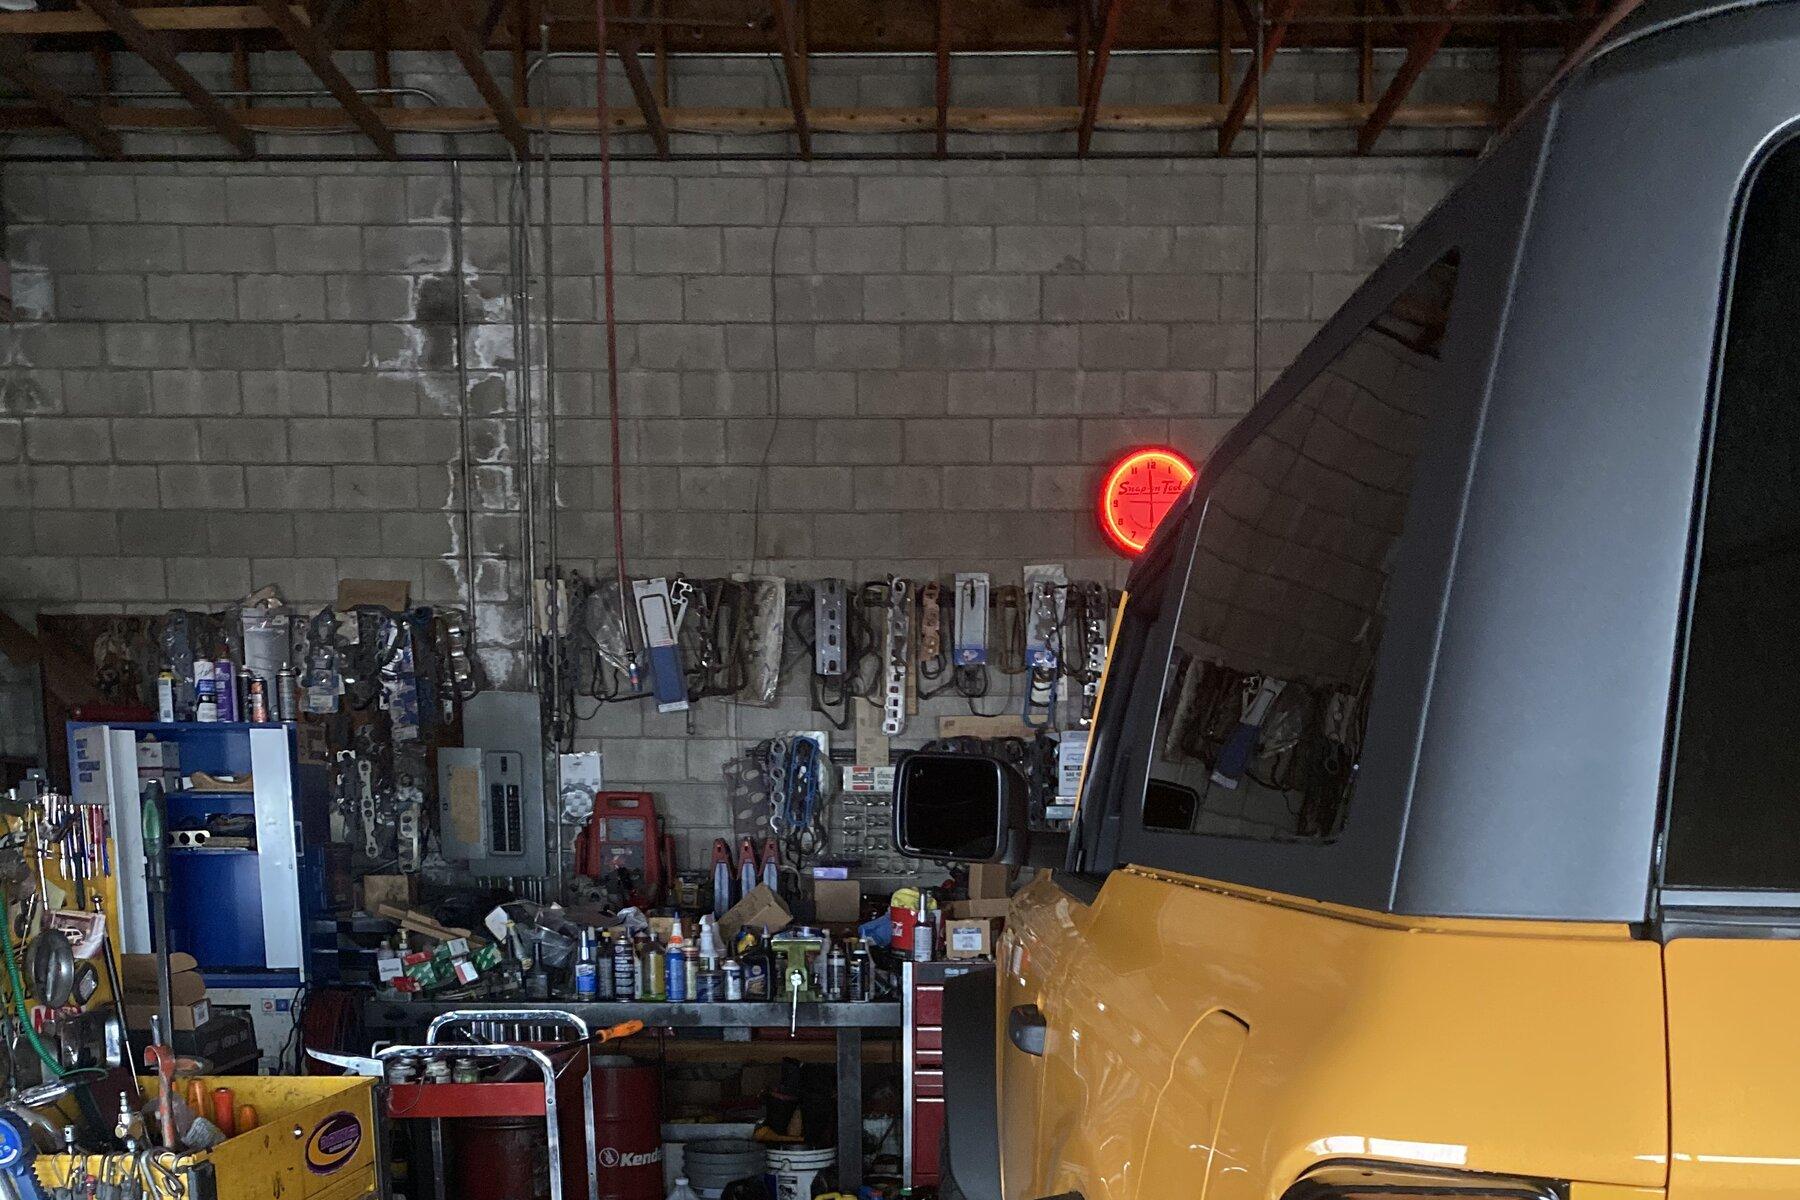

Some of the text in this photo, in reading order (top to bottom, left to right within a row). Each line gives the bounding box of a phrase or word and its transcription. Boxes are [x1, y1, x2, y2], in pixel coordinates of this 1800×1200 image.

[1147, 461, 1156, 470] 12
[1131, 531, 1137, 539] 7
[620, 1147, 662, 1167] Kend
